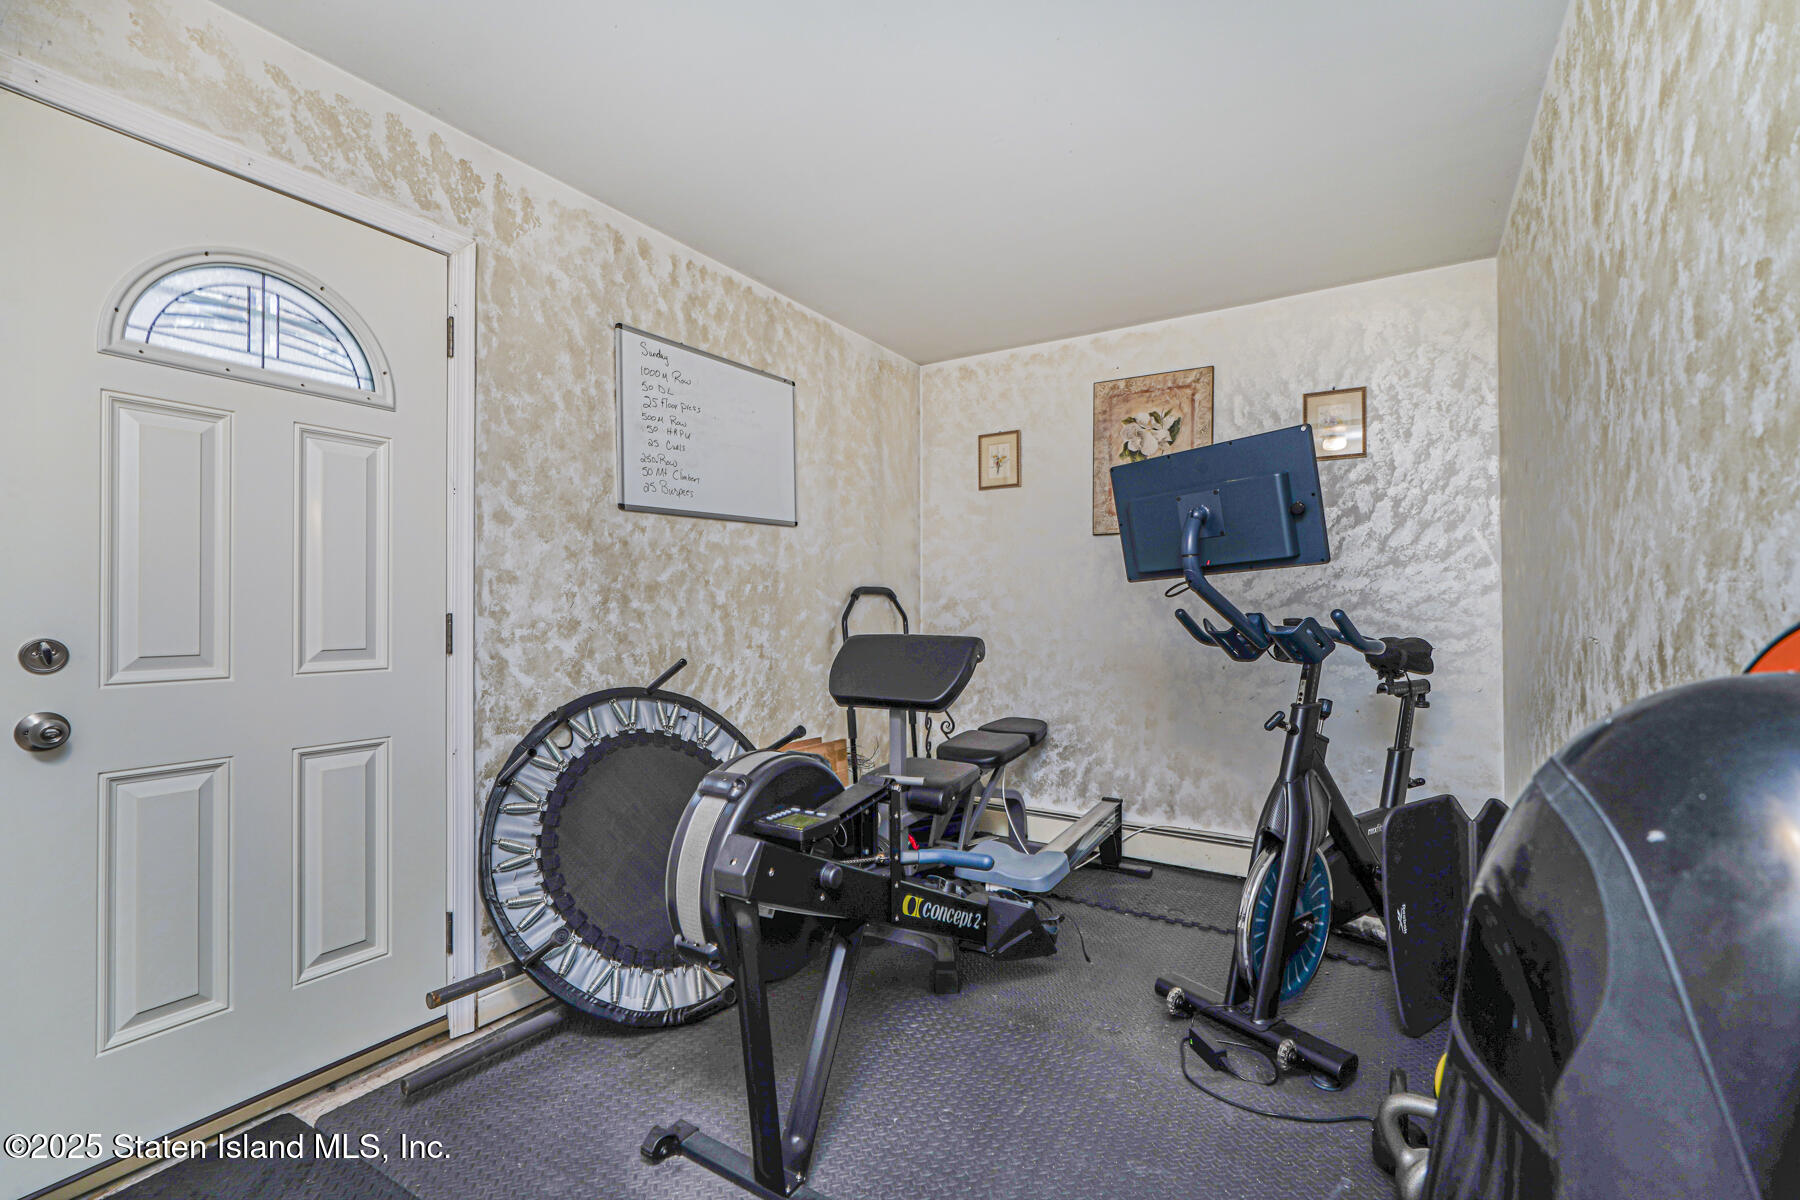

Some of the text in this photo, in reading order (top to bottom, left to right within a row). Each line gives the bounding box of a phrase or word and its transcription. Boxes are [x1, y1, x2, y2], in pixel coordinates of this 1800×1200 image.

[640, 341, 670, 367] Sunday
[671, 370, 692, 385] Row
[641, 381, 654, 392] 50
[642, 395, 658, 408] 25
[669, 414, 688, 428] Row
[646, 424, 659, 434] 50
[647, 438, 660, 448] 25
[657, 453, 678, 468] Row
[641, 466, 654, 477] 50
[642, 481, 657, 493] 25
